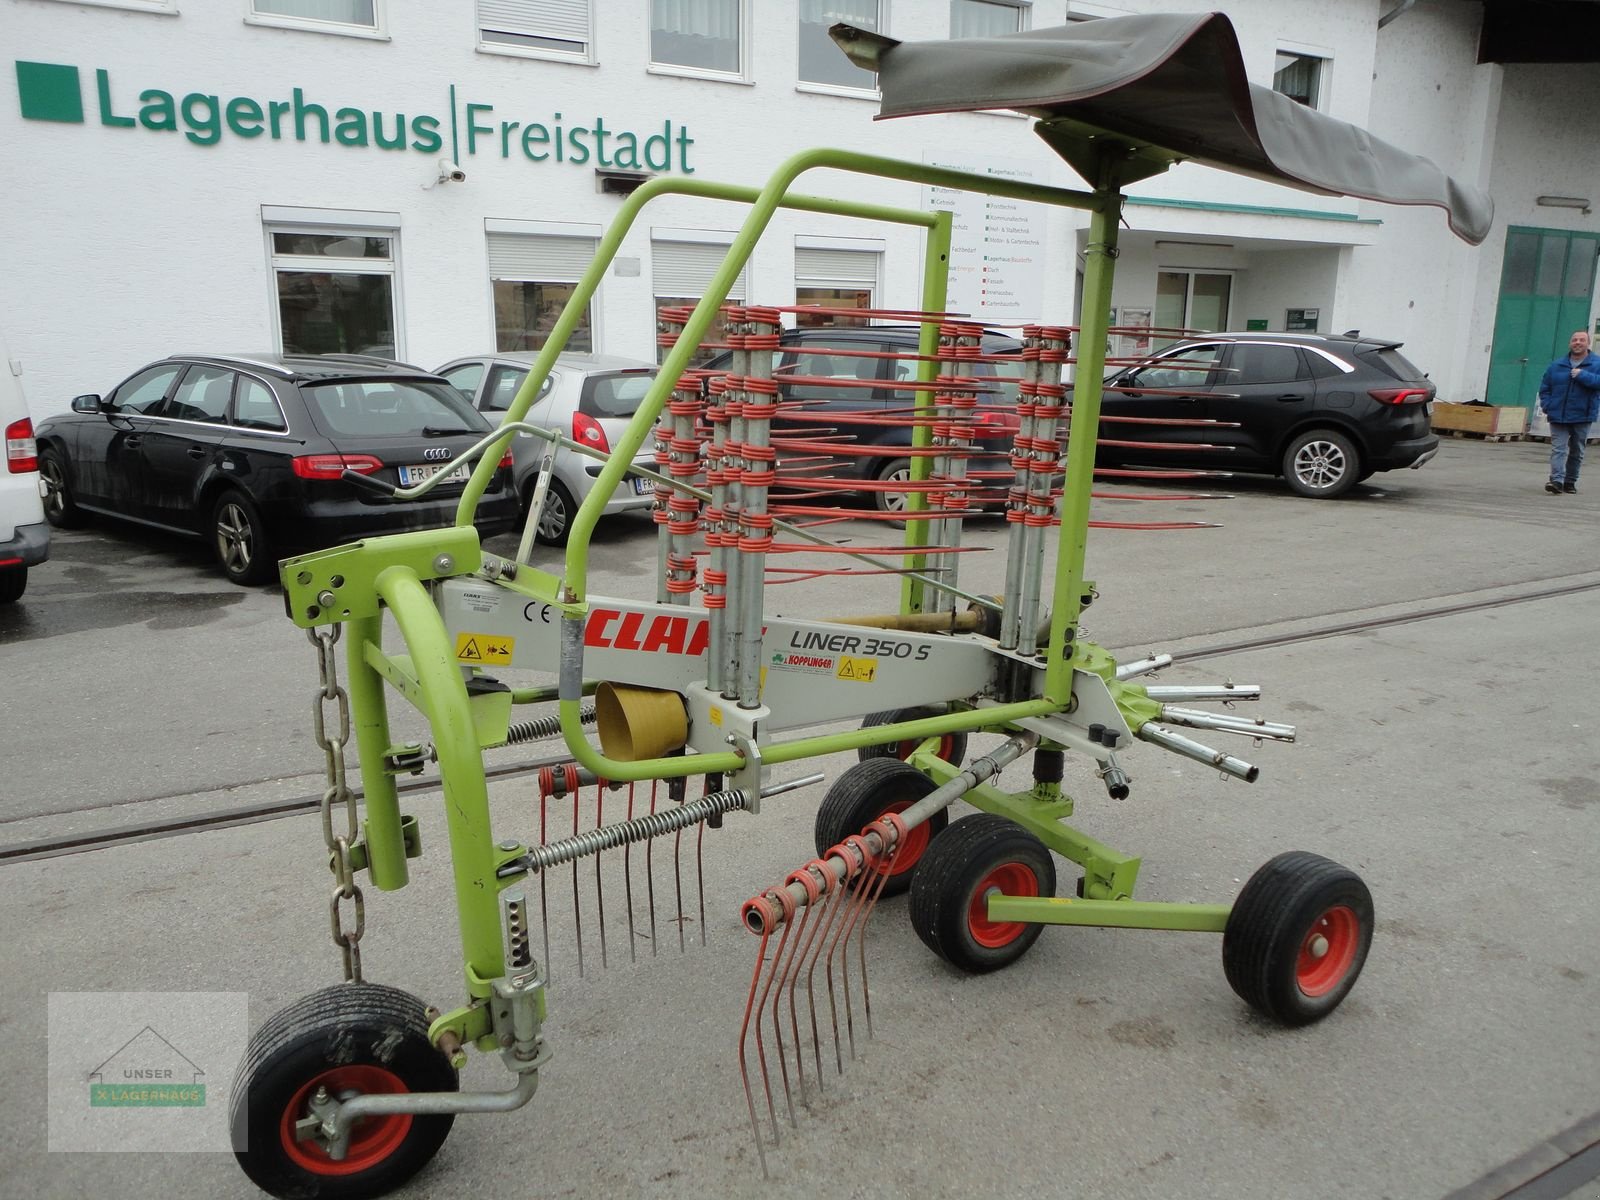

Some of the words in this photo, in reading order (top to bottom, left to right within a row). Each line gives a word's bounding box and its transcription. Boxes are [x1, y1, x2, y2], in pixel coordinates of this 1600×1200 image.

[96, 68, 442, 153] Lagerhaus
[467, 103, 696, 175] Freistadt
[410, 467, 425, 481] FR
[584, 609, 768, 656] CLAA
[790, 631, 861, 653] LINER
[862, 638, 912, 659] 350
[915, 645, 932, 661] S
